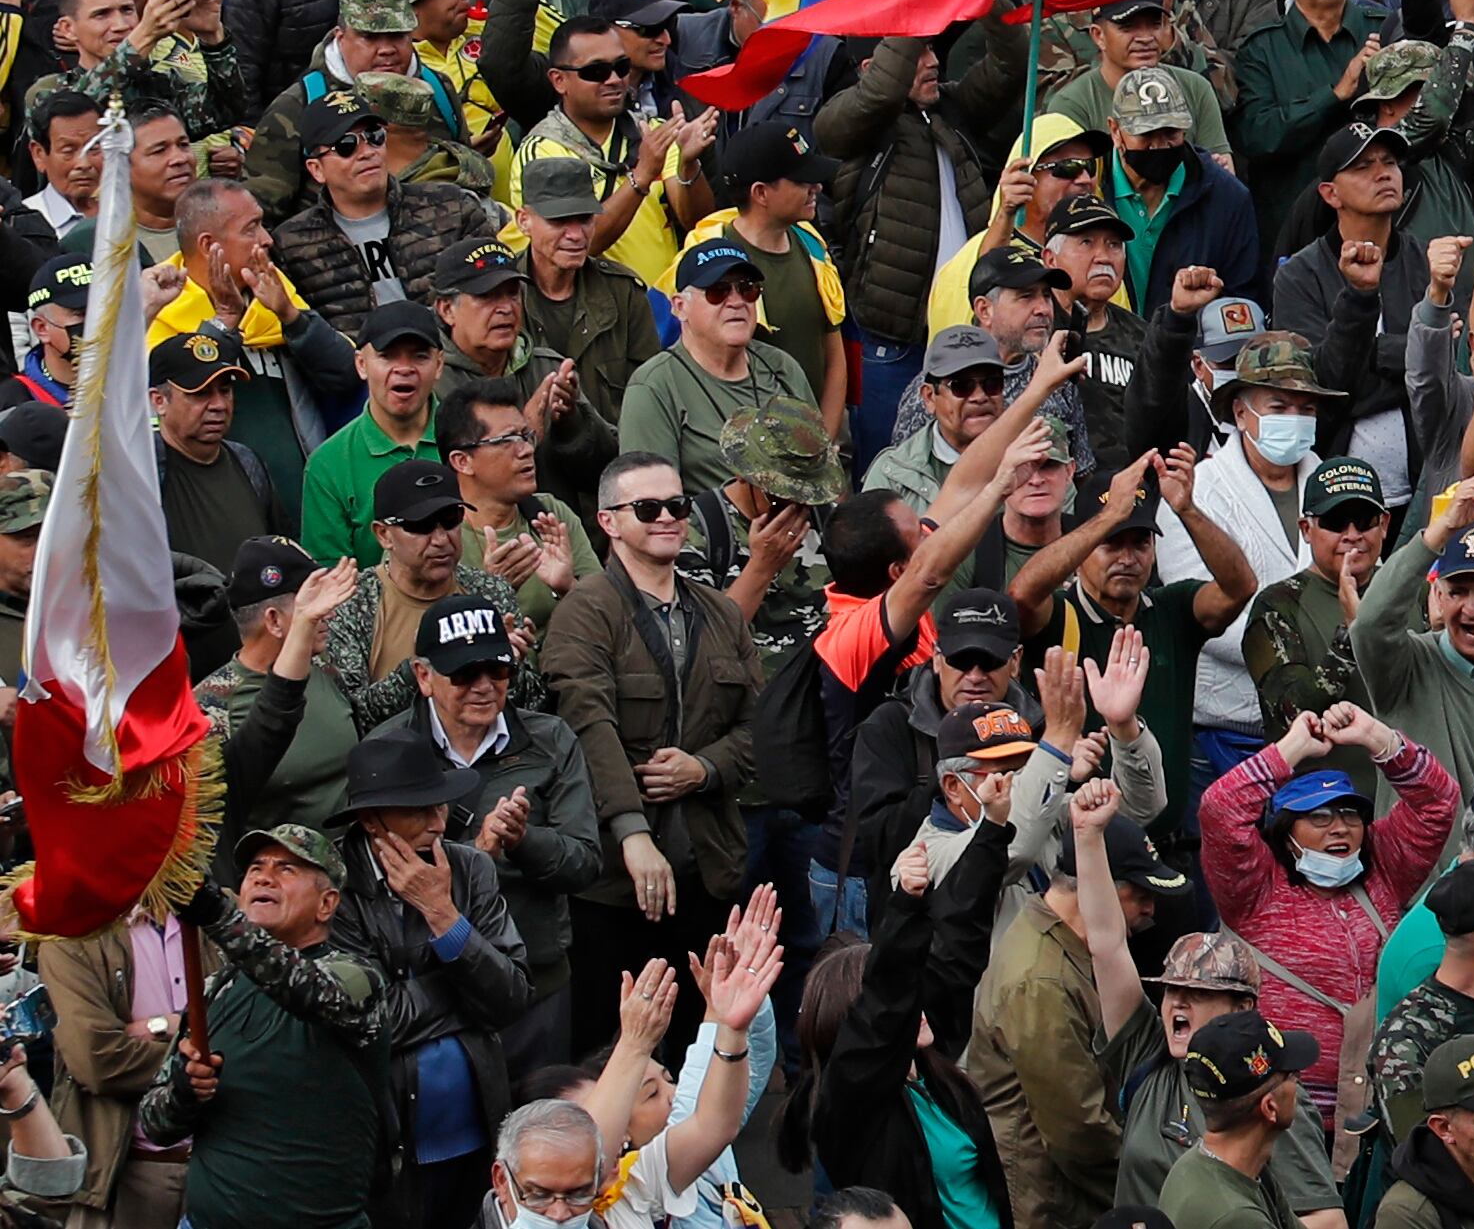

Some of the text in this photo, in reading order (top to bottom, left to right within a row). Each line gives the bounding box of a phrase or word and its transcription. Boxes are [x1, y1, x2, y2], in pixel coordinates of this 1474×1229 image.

[1318, 465, 1374, 483] COLOMBIA
[1325, 482, 1373, 494] VETERAN
[437, 609, 496, 644] ARMY
